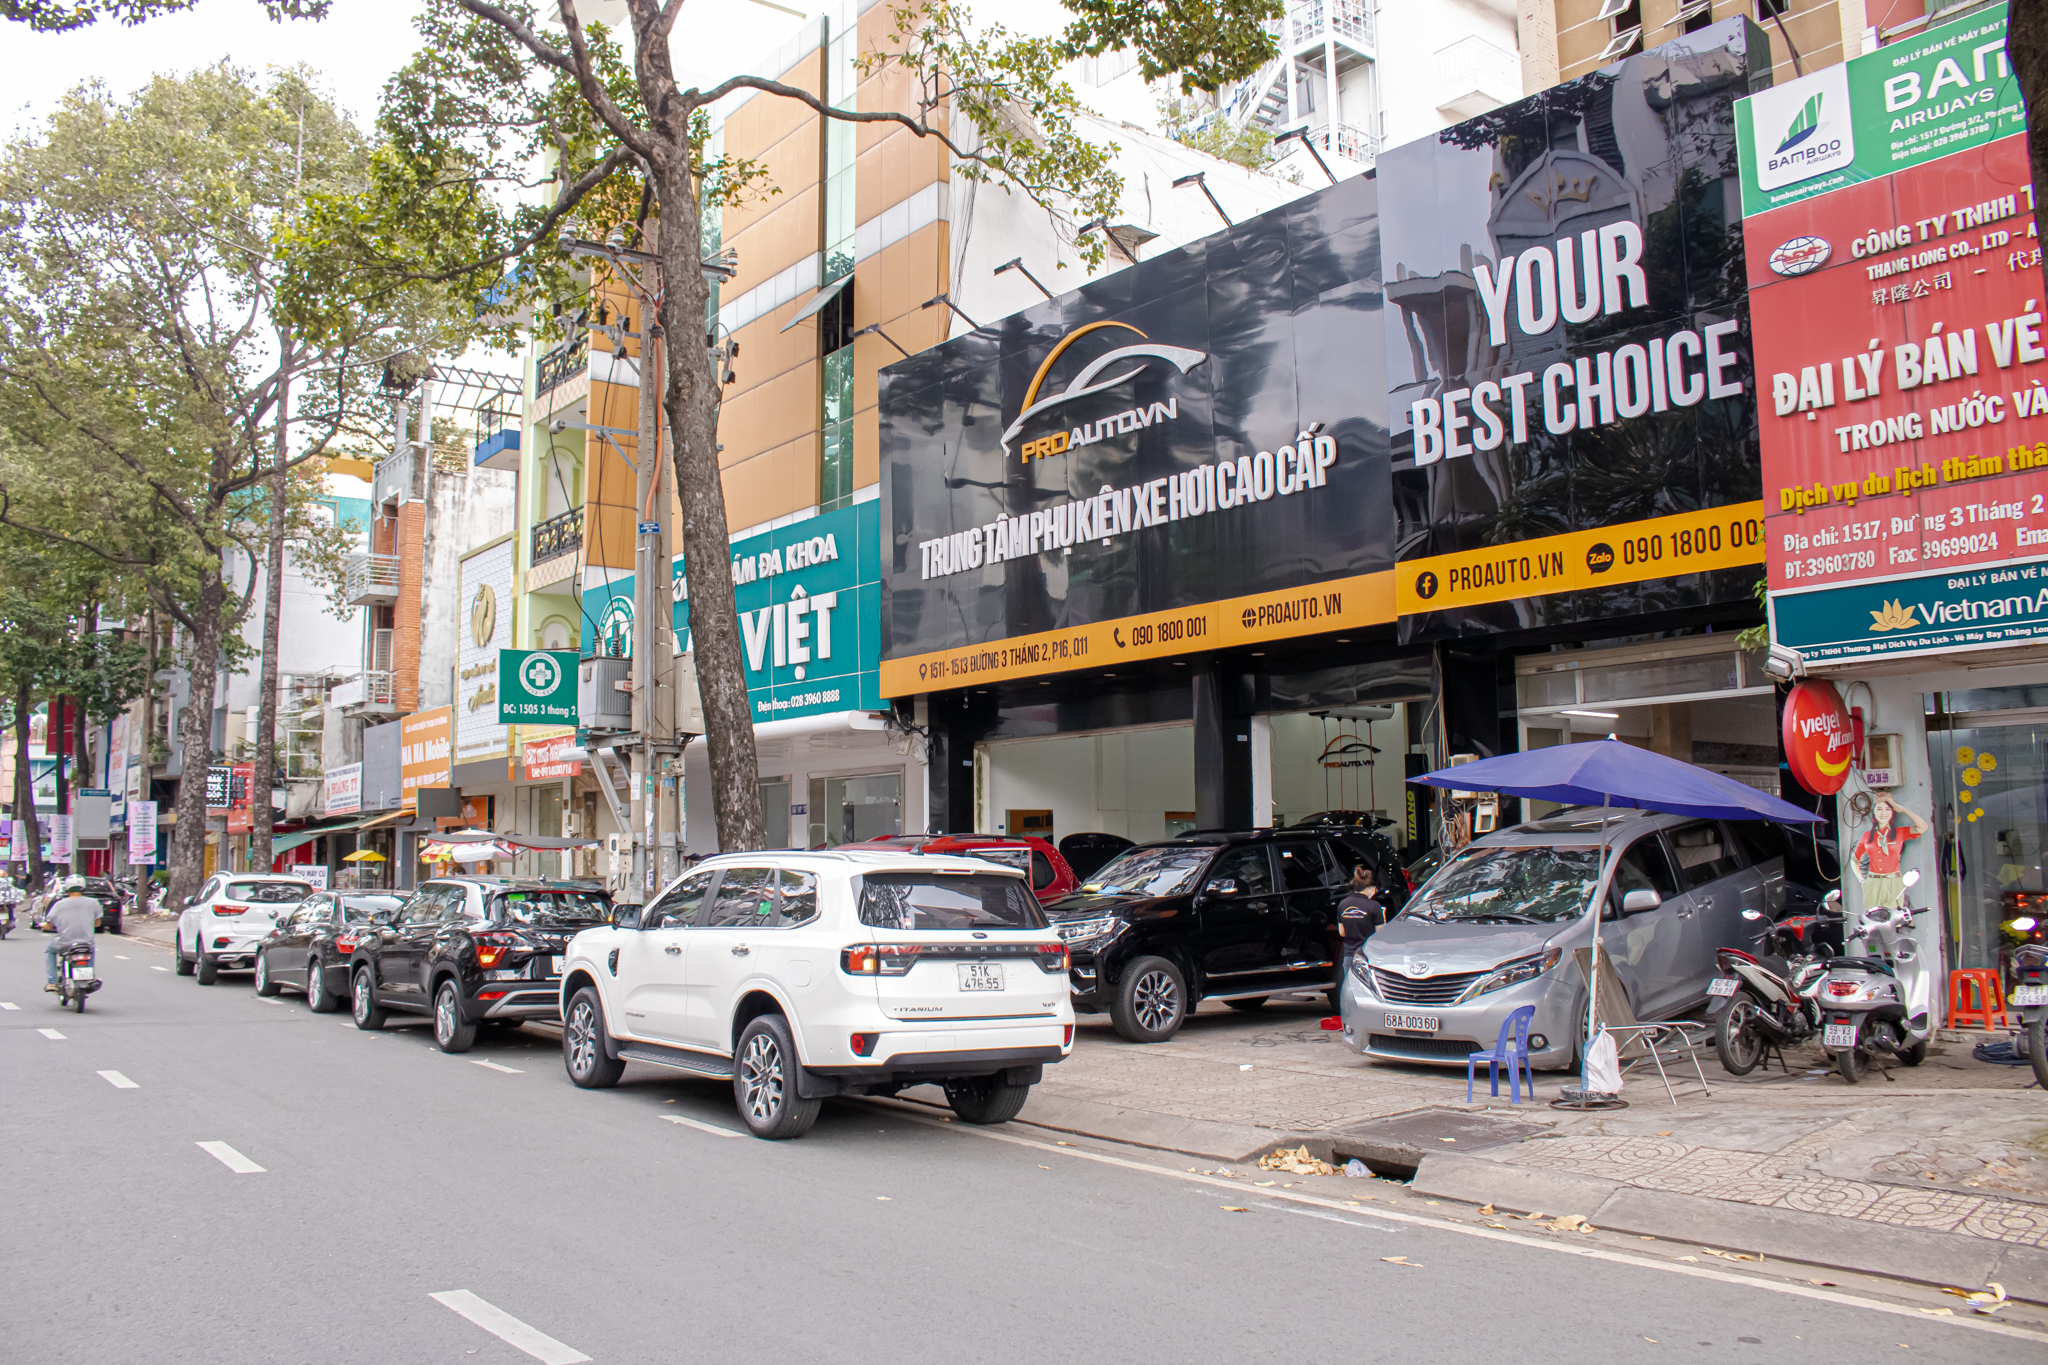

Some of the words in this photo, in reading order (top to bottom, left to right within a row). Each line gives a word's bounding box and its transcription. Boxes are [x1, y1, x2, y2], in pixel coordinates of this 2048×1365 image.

[1893, 55, 1909, 68] ĐẠI
[1910, 48, 1921, 62] LÝ
[1922, 42, 1943, 56] BÁN
[1944, 35, 1957, 49] VÉ
[1958, 28, 1979, 44] MÁY
[1980, 22, 2000, 36] BAY
[1884, 37, 2008, 114] BAM
[1889, 87, 1995, 134] AIRWAYS
[1920, 128, 1938, 141] 1517
[1933, 135, 1948, 148] 028
[1949, 130, 1968, 143] 3960
[1970, 123, 1990, 137] 3780
[1768, 139, 1841, 171] BAMBOO
[1806, 150, 1842, 166] AIRWAYS
[1770, 175, 1845, 203] bambooairways.com
[1851, 226, 1912, 259] CÔNG
[1916, 214, 1948, 241] TY
[1952, 194, 2017, 231] TNHH
[1867, 256, 1910, 281] THANG
[1911, 247, 1947, 269] LONG
[1949, 240, 1980, 260] CO.,
[1982, 230, 2010, 250] LTD
[1472, 220, 1649, 348] YOUR
[1773, 362, 1836, 421] ĐẠI
[1843, 338, 1884, 402] LÝ
[1895, 322, 1979, 391] BÁN
[1986, 299, 2047, 368] VÉ
[1411, 371, 1534, 468] BEST
[1541, 319, 1744, 436] CHOICE
[1022, 397, 1178, 465] PROAUTO.VN
[1835, 412, 1924, 453] TRONG
[1930, 389, 2006, 435] NƯỚC
[2012, 379, 2048, 419] VÀ
[1780, 481, 1829, 515] Dịch
[1832, 481, 1858, 506] vụ
[1863, 472, 1890, 496] du
[1895, 462, 1937, 497] lịch
[1941, 454, 2003, 482] thăm
[2007, 441, 2048, 472] thâ
[919, 528, 985, 580] TRUNG
[982, 512, 1032, 564] TÂM
[1030, 504, 1075, 556] PHỤ
[1074, 484, 1133, 546] KIỆN
[1132, 477, 1169, 530] XE
[1169, 464, 1218, 521] HƠI
[1217, 451, 1275, 509] CAO
[1275, 421, 1339, 496] CẤP
[1783, 533, 1809, 555] Địa
[1812, 526, 1839, 548] chỉ:
[1842, 520, 1888, 544] 1517,
[1950, 507, 1965, 527] 3
[1966, 500, 2024, 523] Tháng
[2031, 494, 2045, 514] 2
[732, 553, 757, 586] ÁM
[758, 548, 784, 579] ĐA
[786, 533, 839, 572] KHOA
[1449, 551, 1564, 592] PROAUTO.VN
[1589, 552, 1612, 565] Zalo
[1622, 535, 1664, 565] 090
[1670, 525, 1722, 558] 1800
[1889, 545, 1918, 566] Fax:
[1922, 531, 1999, 560] 39699024
[2016, 526, 2048, 547] Ema
[1948, 577, 1971, 591] ĐẠI
[1972, 571, 1988, 588] LÝ
[1991, 569, 2018, 586] BÁN
[2021, 565, 2038, 580] VÉ
[740, 584, 838, 681] VIỆT
[1132, 624, 1153, 647] 090
[1157, 618, 1184, 643] 1800
[1186, 615, 1207, 637] 001
[1258, 592, 1342, 627] PROAUTO.VN
[969, 649, 1000, 673] ĐƯỜNG
[1001, 650, 1008, 667] 3
[1009, 642, 1040, 666] THÁNG
[1041, 645, 1051, 663] 2,
[1073, 636, 1088, 656] Q11
[1820, 646, 1841, 657] TNHH
[1843, 642, 1871, 655] Thương
[1919, 636, 1931, 645] Du
[1966, 630, 1984, 642] Máy
[1986, 628, 2002, 640] Bay
[2004, 626, 2031, 638] Thăng
[2034, 624, 2048, 634] Lon
[503, 703, 516, 714] ĐC:
[519, 704, 538, 715] 1505
[540, 704, 545, 715] 3
[547, 703, 569, 719] tháng
[571, 705, 576, 716] 2
[790, 694, 804, 709] 028
[804, 692, 822, 708] 3960
[823, 688, 840, 703] 8888
[1800, 710, 1840, 738] Vietjet
[1827, 731, 1853, 753] Air.com
[402, 745, 412, 766] NA
[413, 741, 424, 764] NA
[425, 736, 450, 762] Mobile
[1407, 790, 1418, 841] TITANO
[309, 879, 322, 887] CAO
[964, 977, 1000, 990] 476.55
[970, 965, 990, 978] 51K
[1825, 1034, 1852, 1045] 680.61
[1828, 1025, 1851, 1035] 59-V3
